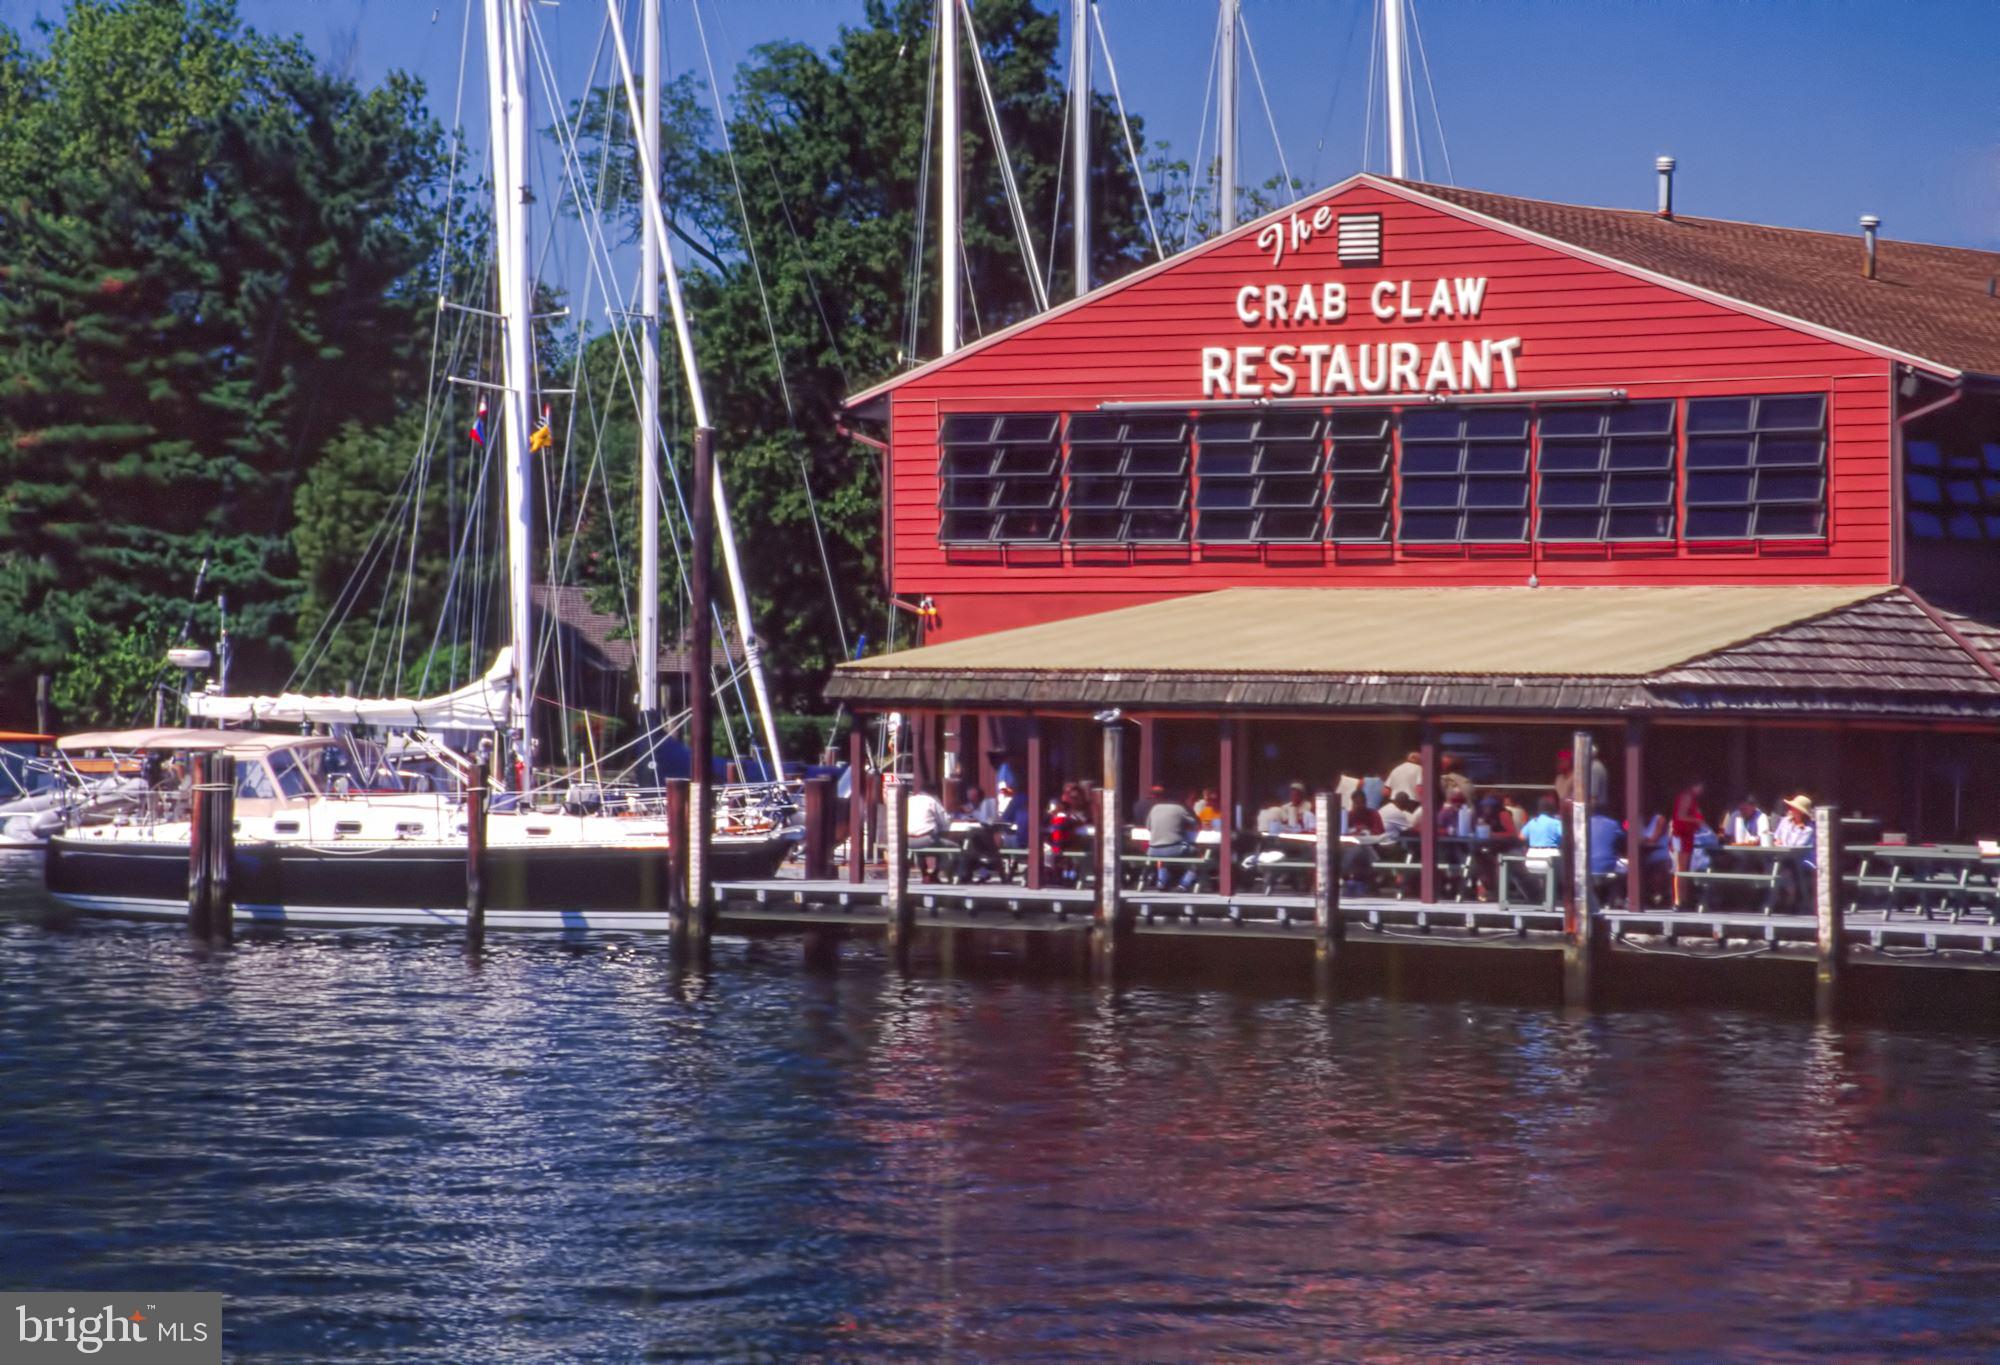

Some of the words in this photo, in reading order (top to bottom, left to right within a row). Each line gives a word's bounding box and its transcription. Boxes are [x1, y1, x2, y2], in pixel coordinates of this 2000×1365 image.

[1257, 206, 1333, 267] The
[1236, 283, 1348, 324] CRAB
[1370, 277, 1488, 320] CLAW
[1202, 337, 1522, 397] RESTAURANT
